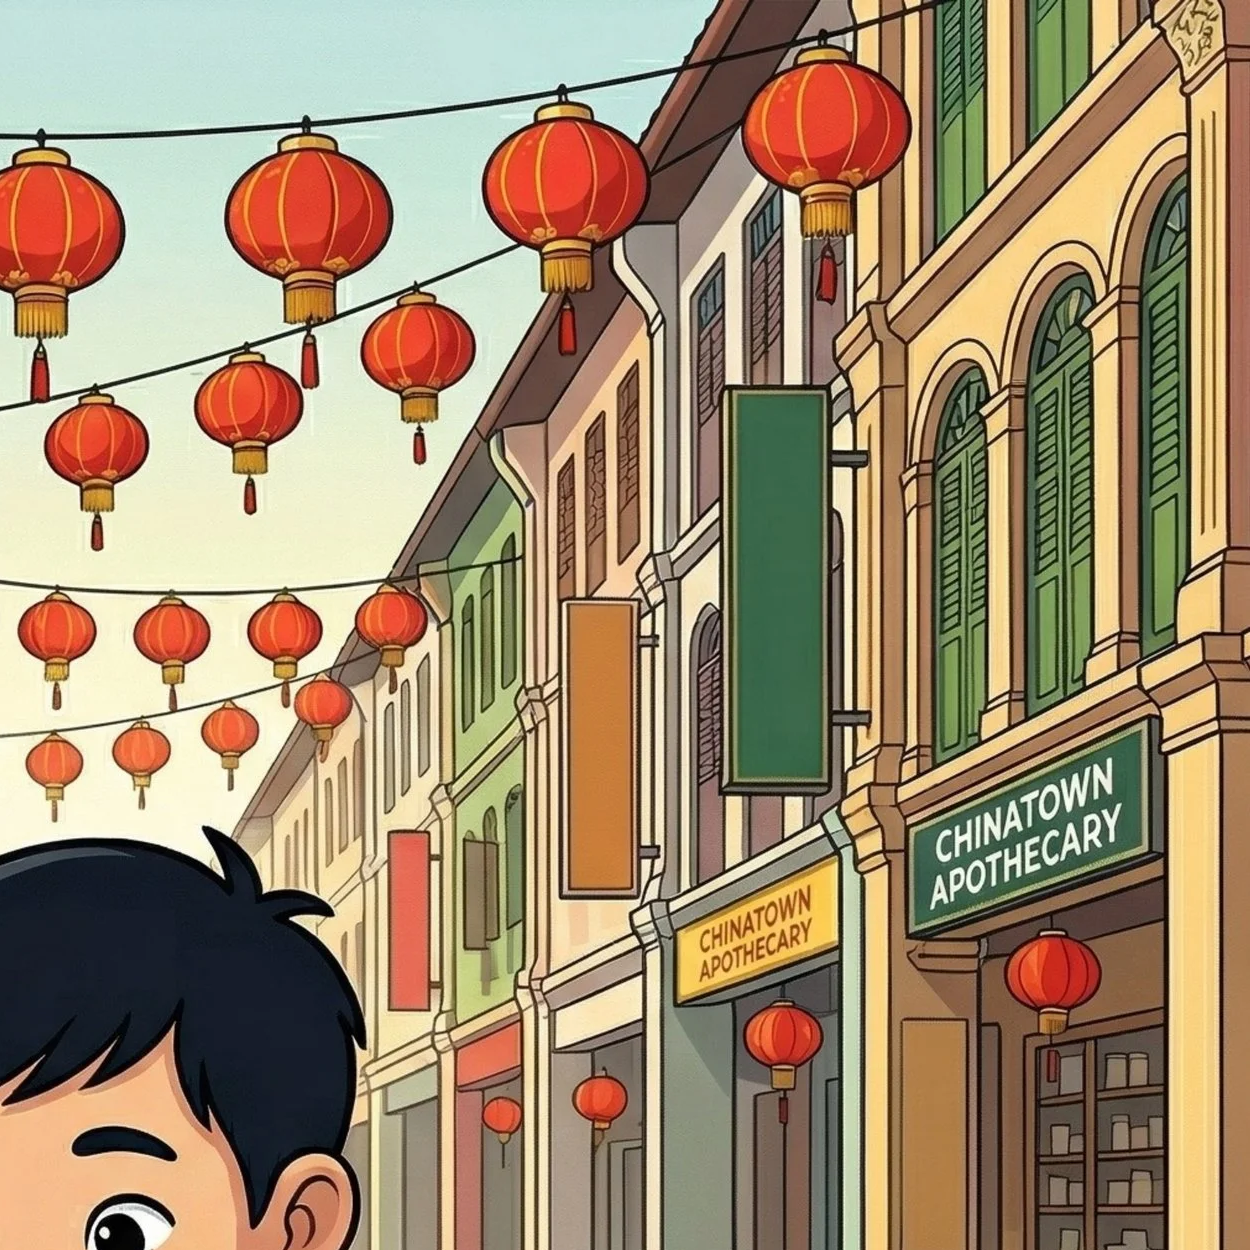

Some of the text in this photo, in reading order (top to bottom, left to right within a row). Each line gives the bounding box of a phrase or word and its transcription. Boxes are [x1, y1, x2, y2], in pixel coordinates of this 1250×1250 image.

[935, 757, 1113, 863] CHINATOWN
[930, 803, 1123, 910] APOTHECARY
[699, 885, 811, 954] CHINATOWN
[699, 917, 813, 983] APOTHECARY
